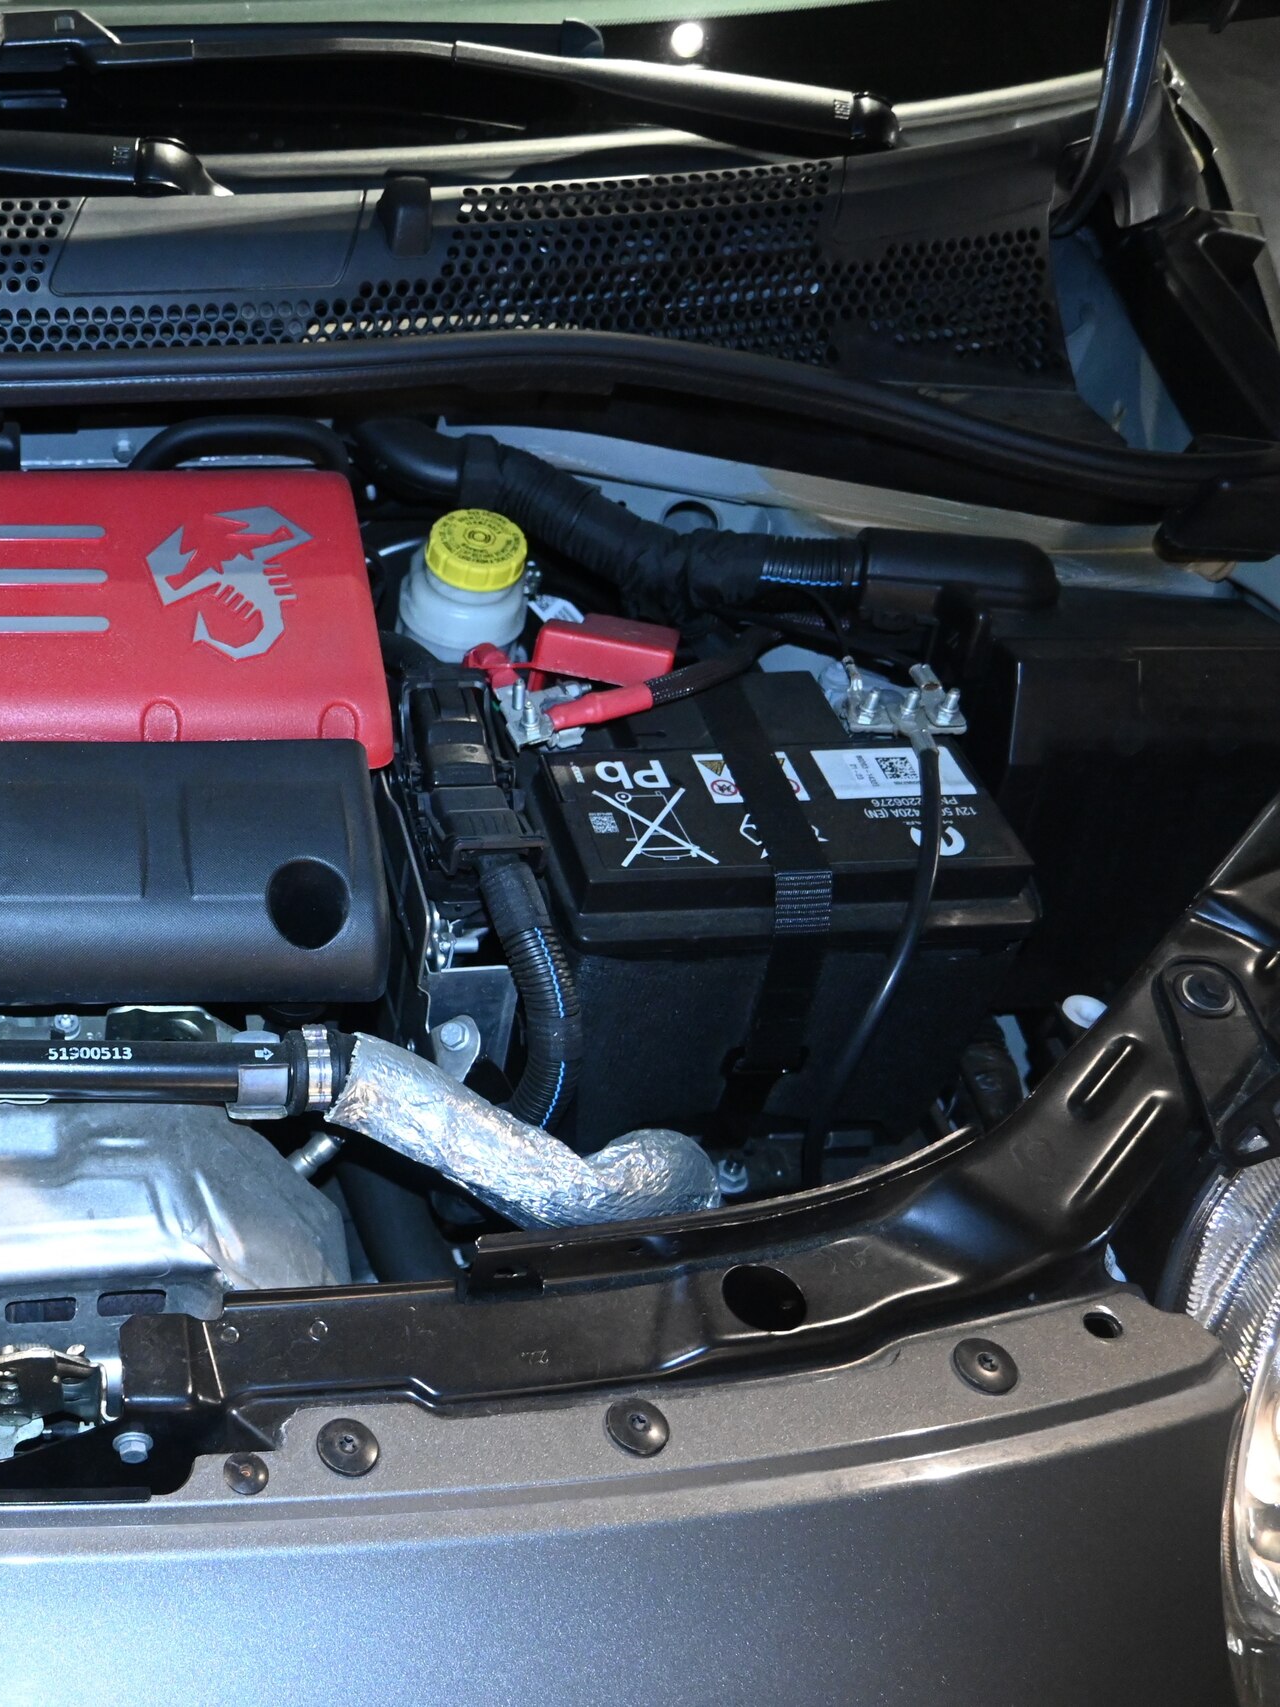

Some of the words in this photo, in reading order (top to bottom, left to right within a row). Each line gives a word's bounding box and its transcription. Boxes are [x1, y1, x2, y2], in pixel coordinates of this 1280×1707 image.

[595, 760, 671, 789] Pb
[871, 797, 922, 807] 2206276
[864, 808, 889, 819] (EN)
[890, 808, 920, 818] 420A
[956, 806, 977, 816] 12V
[48, 1046, 132, 1060] 51900513
